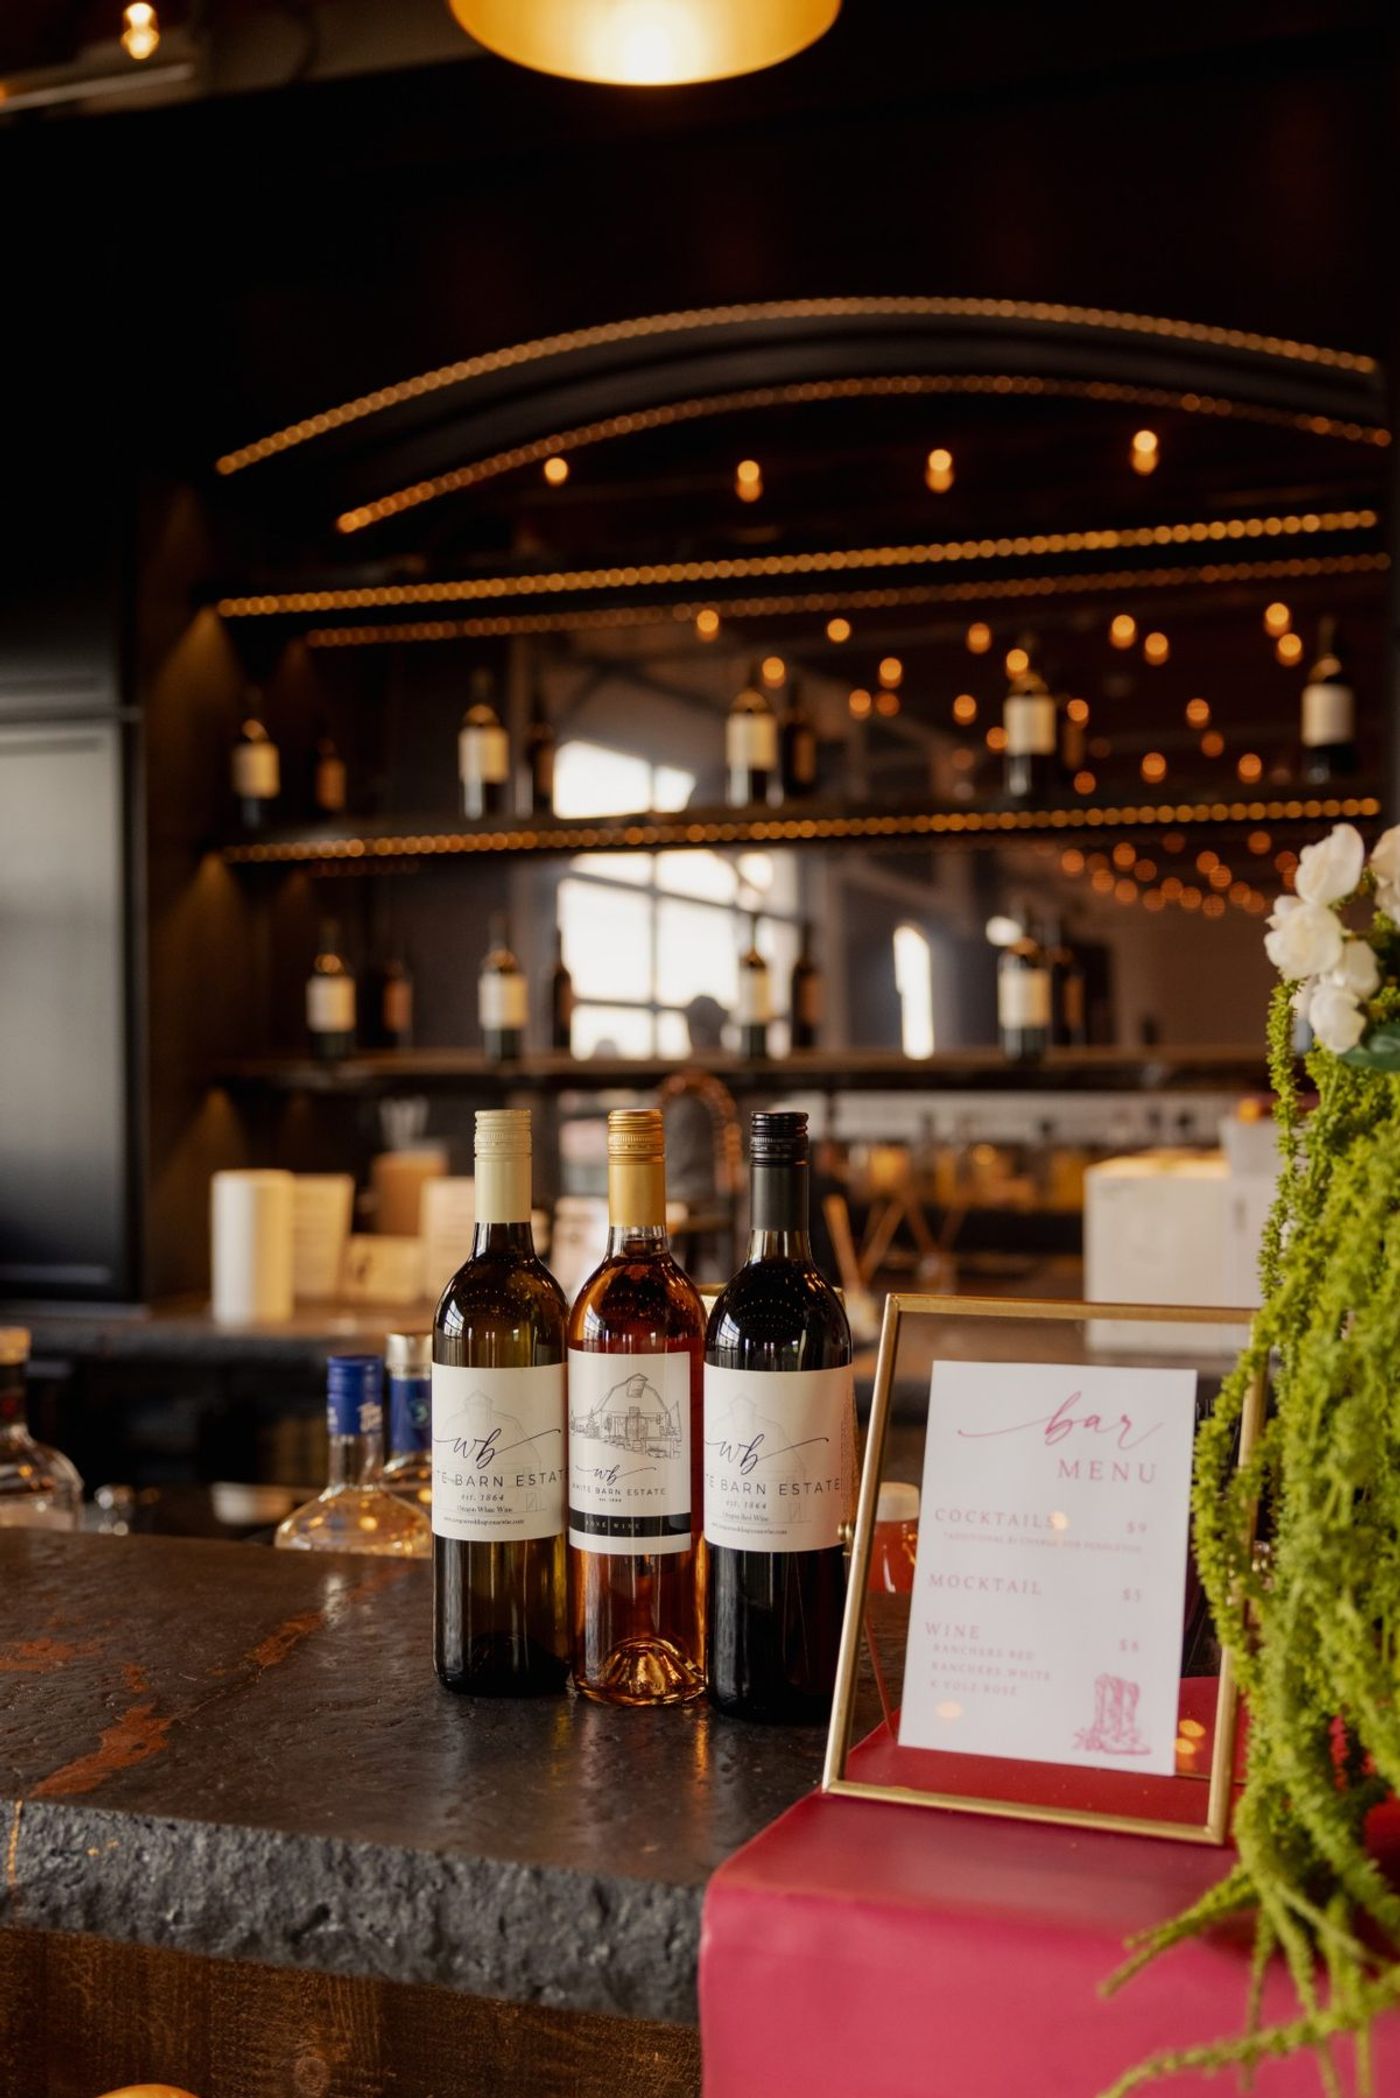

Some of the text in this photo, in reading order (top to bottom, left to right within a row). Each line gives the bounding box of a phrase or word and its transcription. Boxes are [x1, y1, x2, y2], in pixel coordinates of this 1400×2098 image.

[1057, 1458, 1159, 1484] MENU
[455, 1473, 504, 1488] BARN
[720, 1480, 767, 1495] BARN
[778, 1478, 841, 1496] ESTATE
[479, 1493, 505, 1502] 1864
[594, 1487, 621, 1496] BARN
[626, 1487, 668, 1496] ESTATE
[935, 1508, 1056, 1530] COCKTAILS
[928, 1573, 1042, 1596] MOCKTAIL
[925, 1621, 981, 1640] WINE
